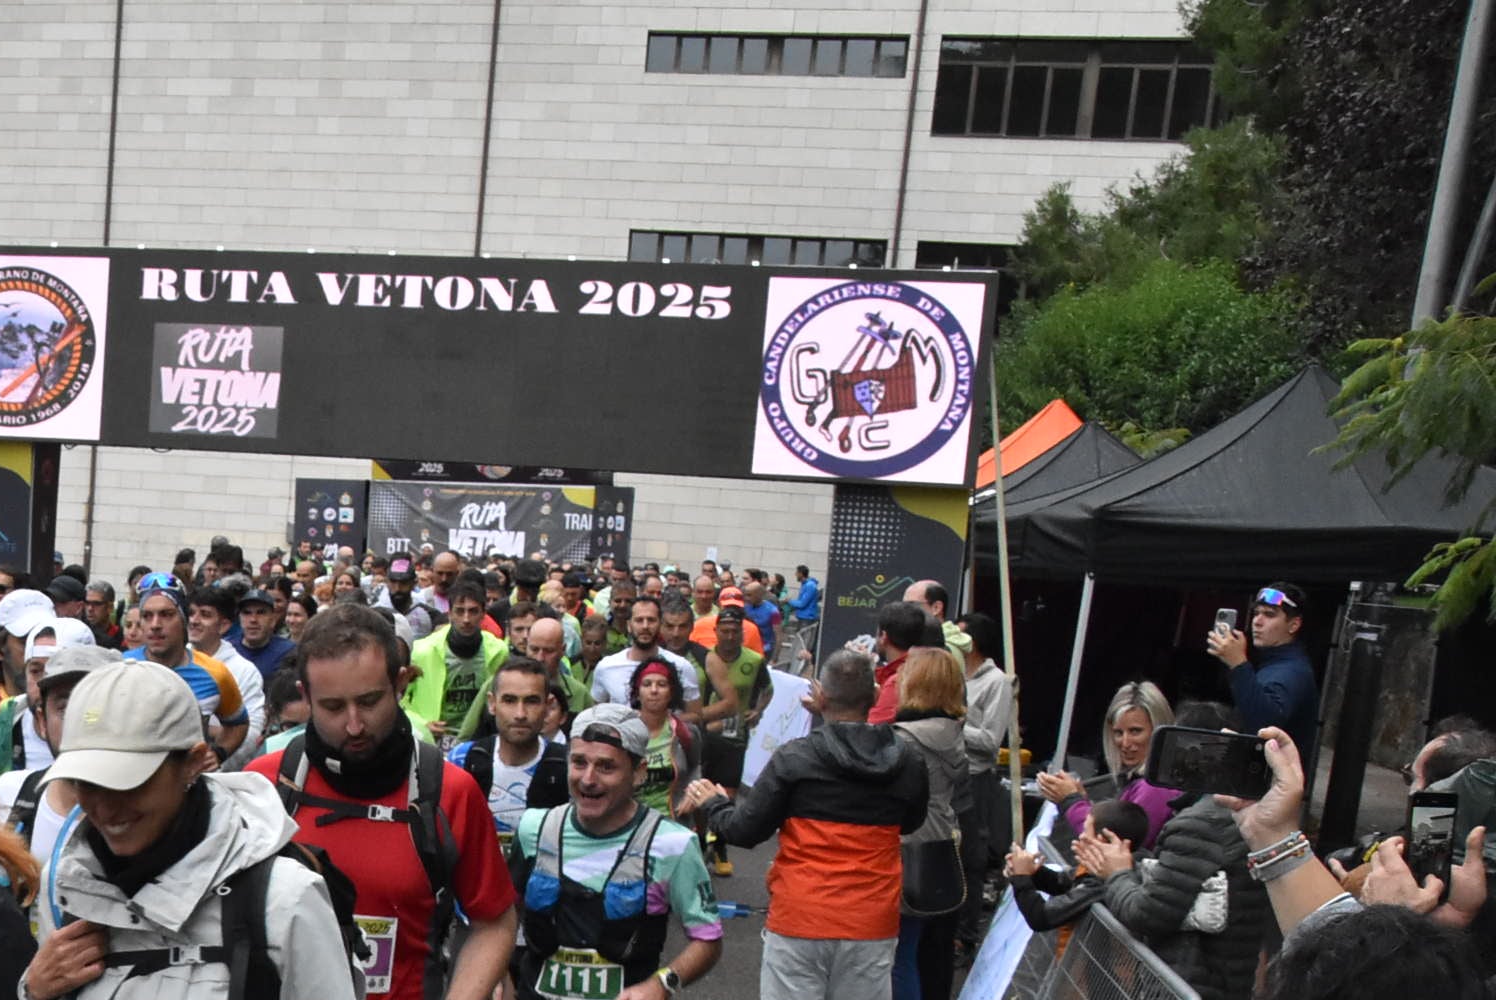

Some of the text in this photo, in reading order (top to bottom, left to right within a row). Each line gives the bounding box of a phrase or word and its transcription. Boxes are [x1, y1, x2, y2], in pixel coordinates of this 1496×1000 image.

[31, 271, 46, 284] DE
[138, 267, 733, 321] RUTA VETONA 2025
[915, 296, 946, 323] DE
[178, 325, 254, 371] RUTA
[764, 283, 903, 386] CANDELARIENSE
[29, 401, 63, 423] 1968
[66, 362, 91, 400] 2018
[160, 367, 281, 409] VETONA
[171, 405, 256, 437] 2025
[767, 402, 819, 462] GRUPO
[460, 501, 507, 531] RUTA
[563, 513, 592, 530] TRAI
[386, 537, 411, 554] BTT
[549, 963, 608, 994] 1111
